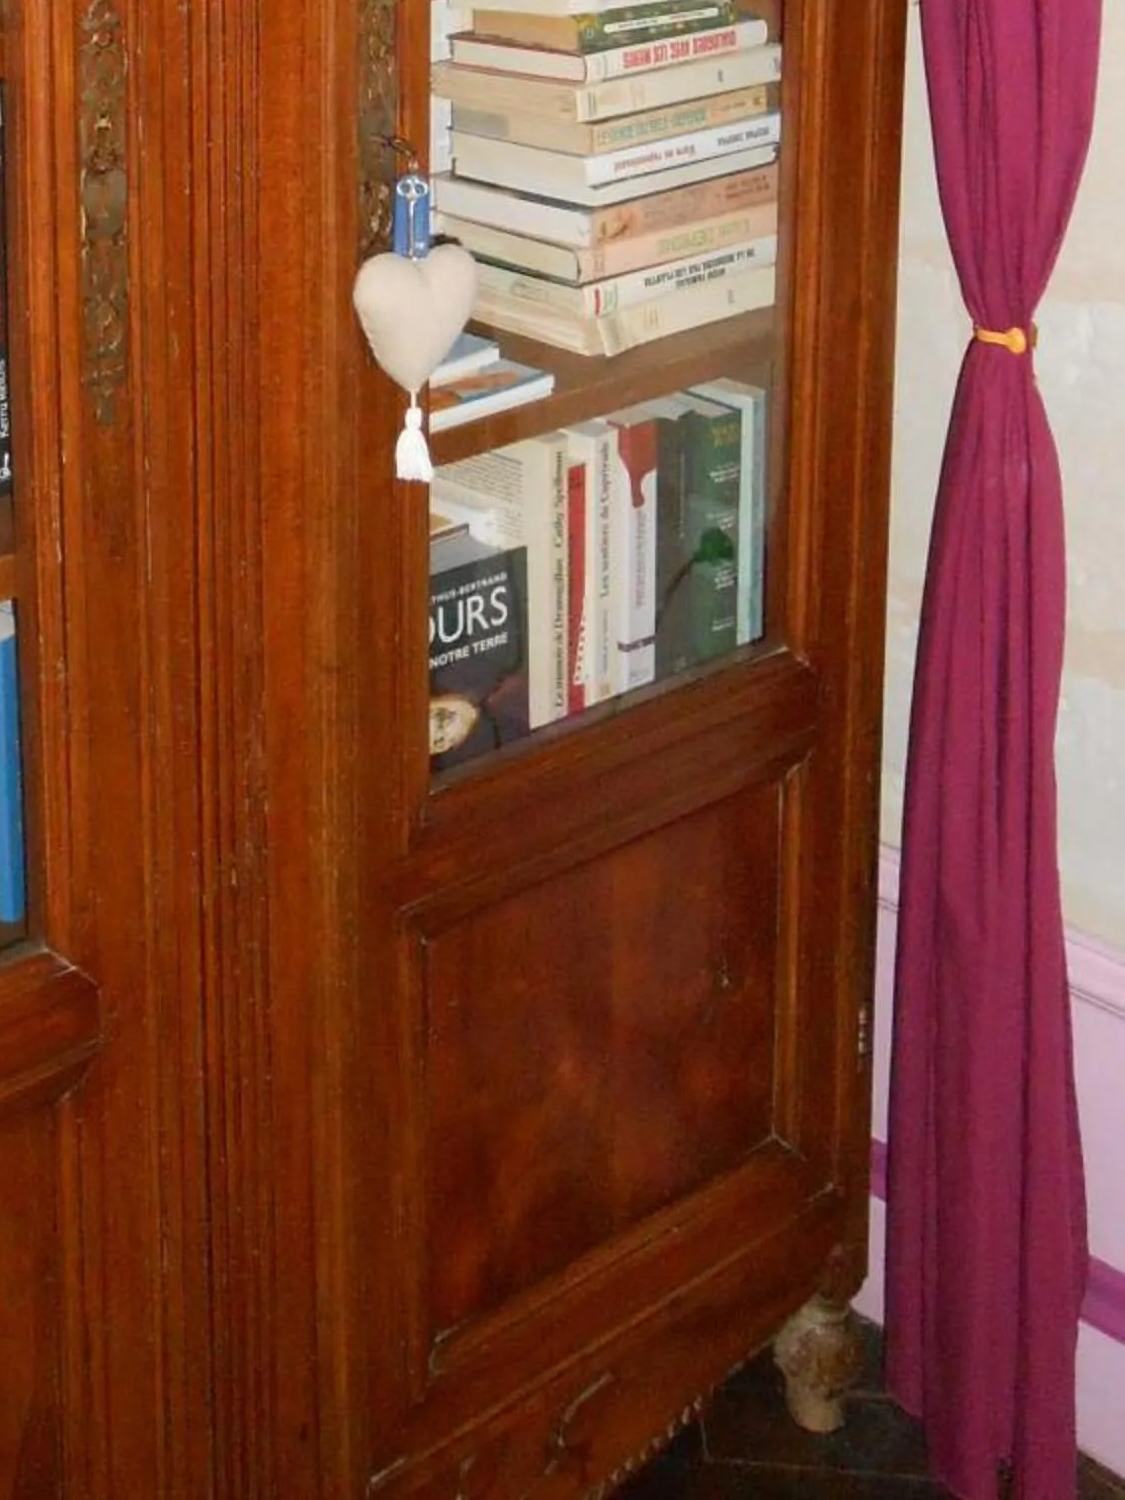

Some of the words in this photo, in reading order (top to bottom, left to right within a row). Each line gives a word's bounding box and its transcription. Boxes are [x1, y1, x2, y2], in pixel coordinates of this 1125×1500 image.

[429, 585, 509, 644] URS
[429, 645, 470, 670] NOTRE
[471, 631, 509, 655] TERRE
